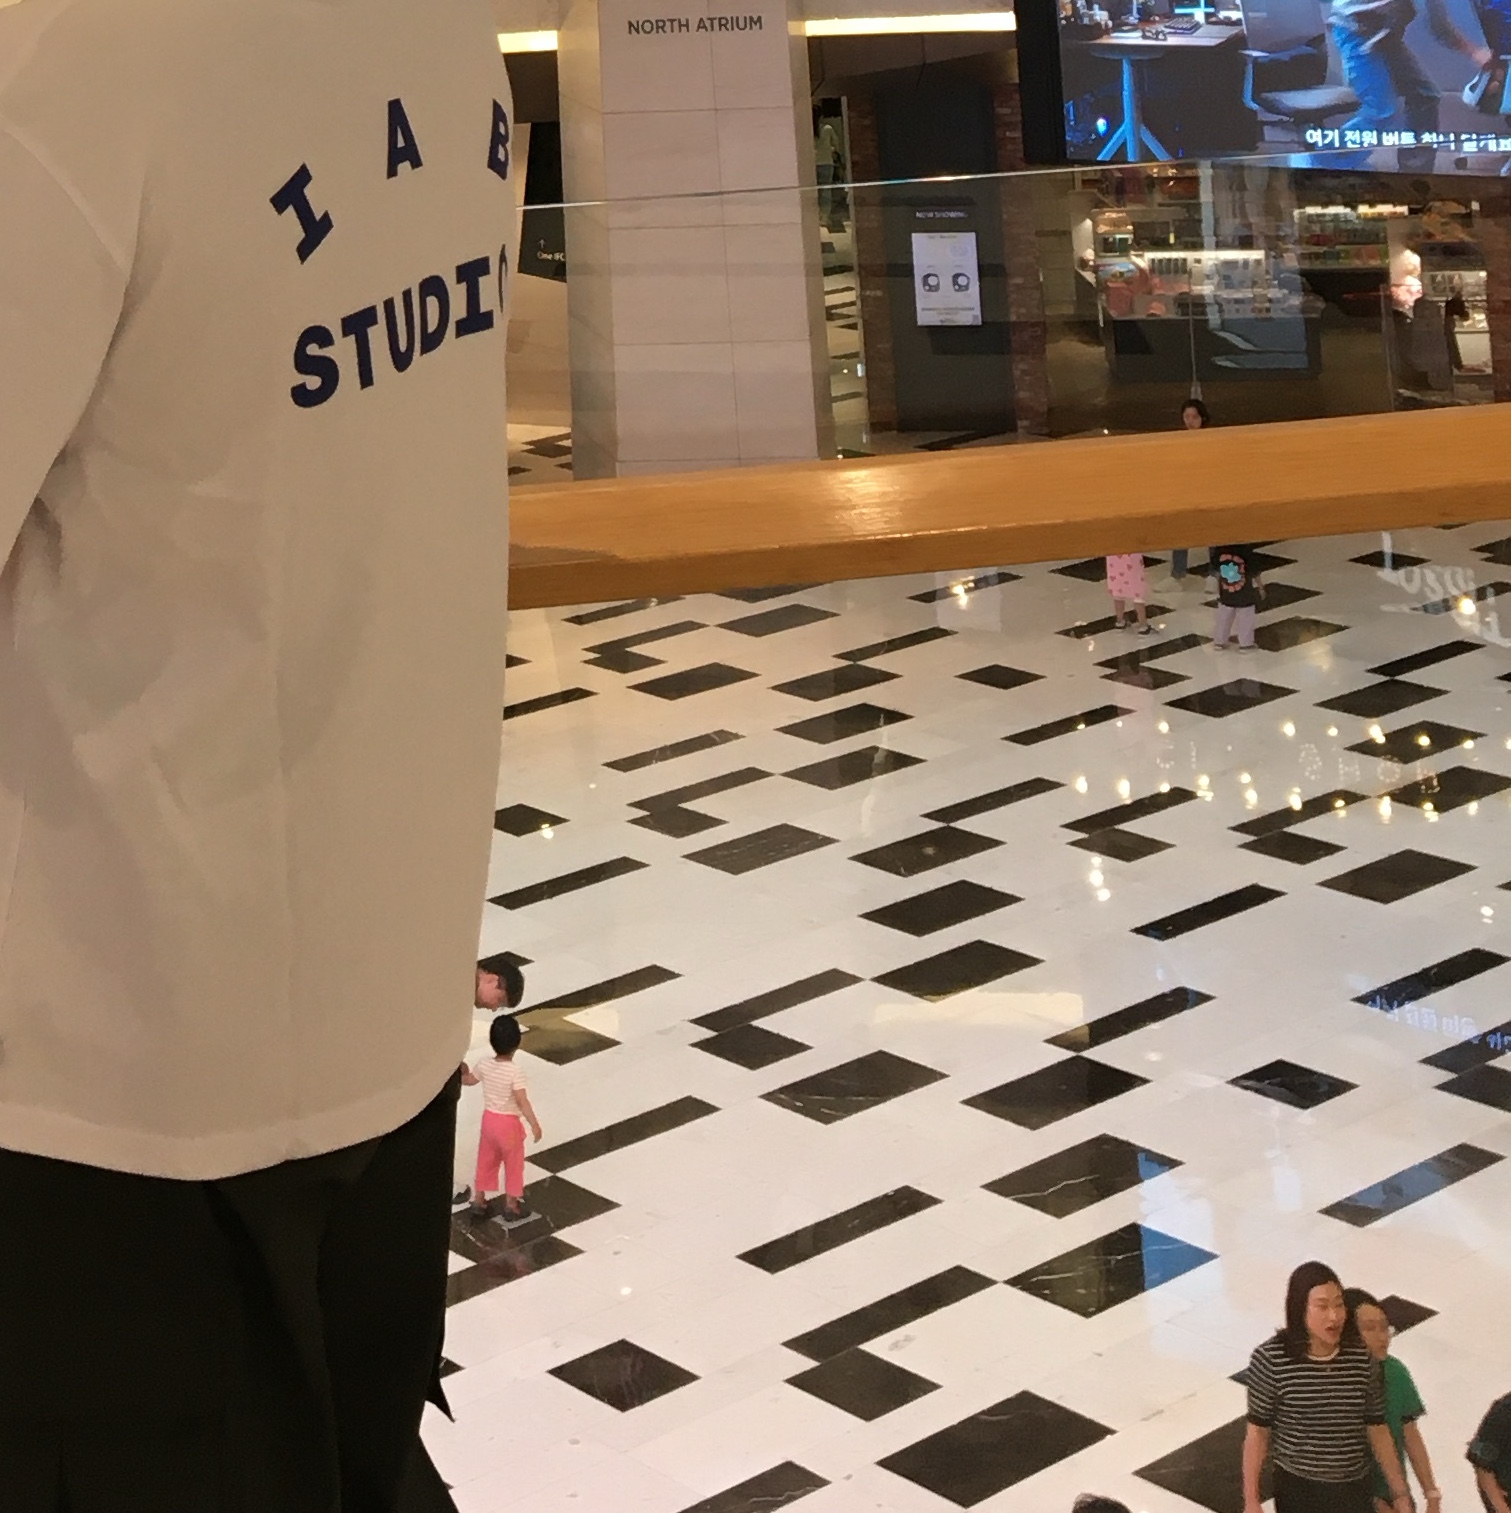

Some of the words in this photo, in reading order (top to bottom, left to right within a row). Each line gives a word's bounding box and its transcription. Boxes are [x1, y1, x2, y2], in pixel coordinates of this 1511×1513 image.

[627, 17, 690, 35] NORTH
[695, 14, 763, 32] ATRIUM
[1305, 129, 1340, 149] 여기
[1345, 129, 1379, 149] 전원
